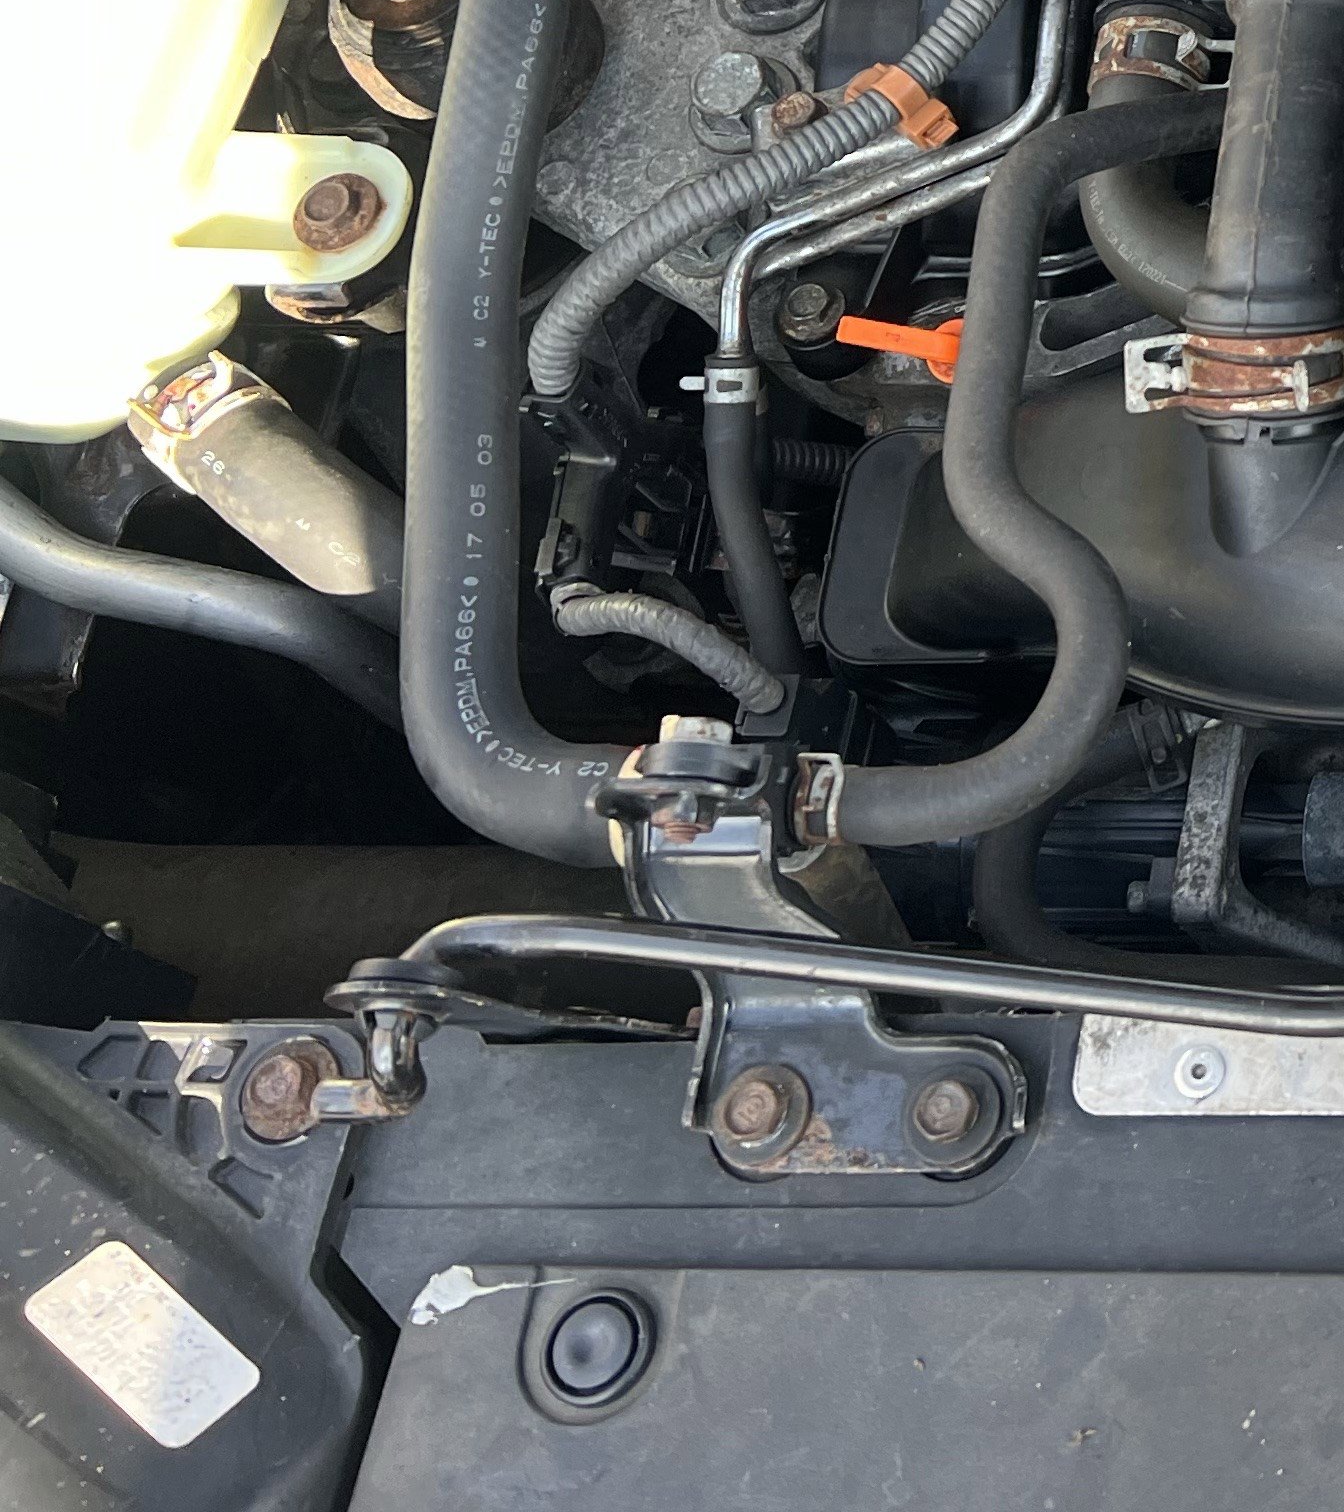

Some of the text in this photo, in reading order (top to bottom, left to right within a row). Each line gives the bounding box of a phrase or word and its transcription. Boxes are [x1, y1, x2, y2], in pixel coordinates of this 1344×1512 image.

[477, 213, 502, 280] Y-TEC
[476, 433, 494, 466] 03
[469, 482, 487, 518] 05
[465, 531, 484, 561] 17
